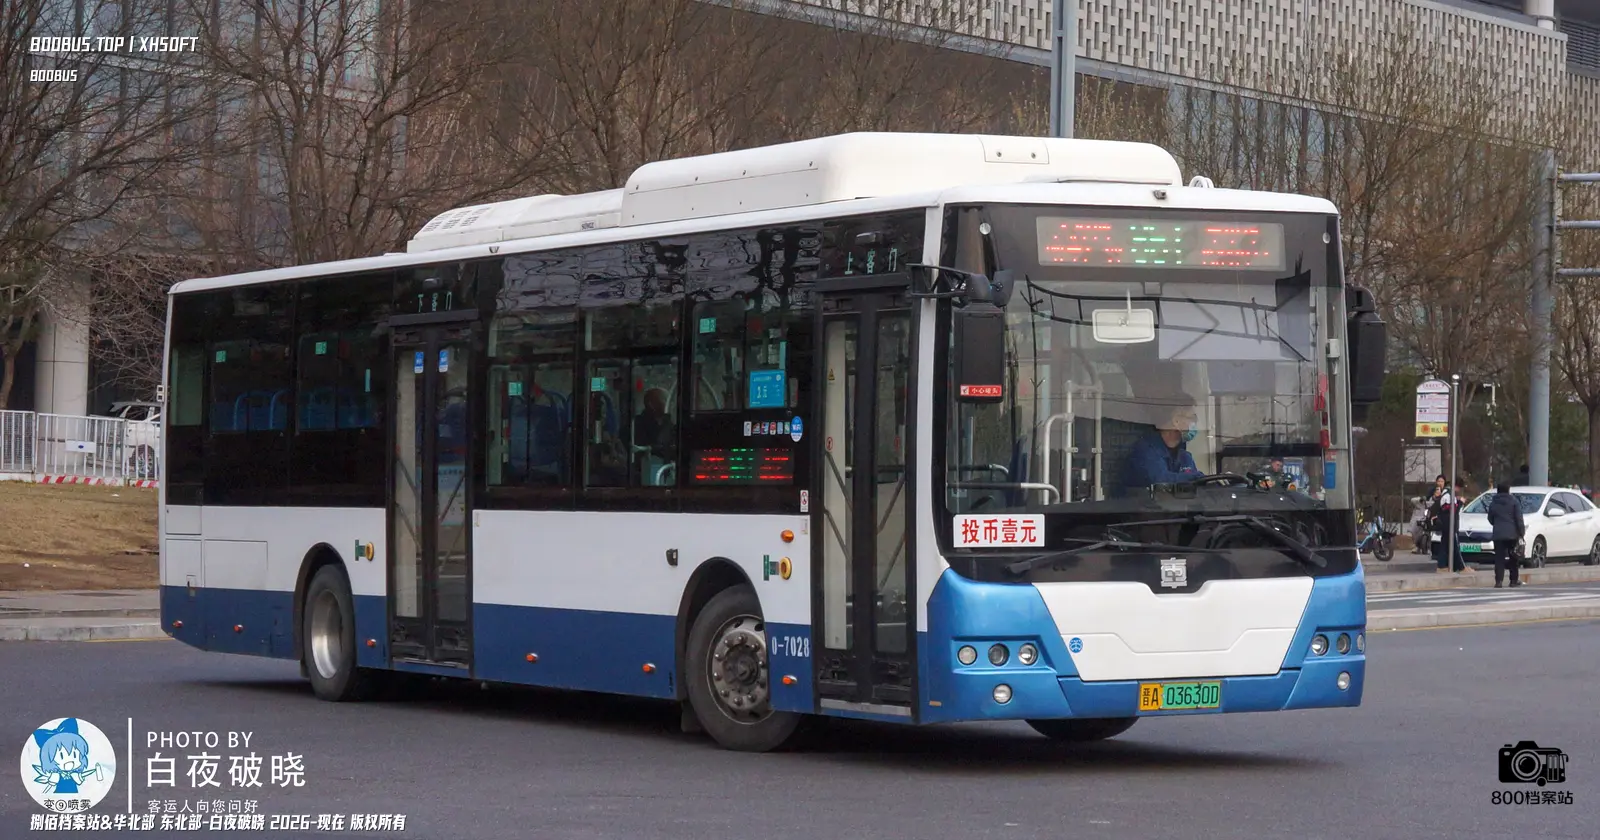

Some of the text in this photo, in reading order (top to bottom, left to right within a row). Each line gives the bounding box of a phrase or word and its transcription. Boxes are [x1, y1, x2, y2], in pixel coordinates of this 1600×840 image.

[844, 247, 897, 275] 上客门
[962, 518, 1037, 544] 投币壹元
[771, 636, 810, 657] 0-7028
